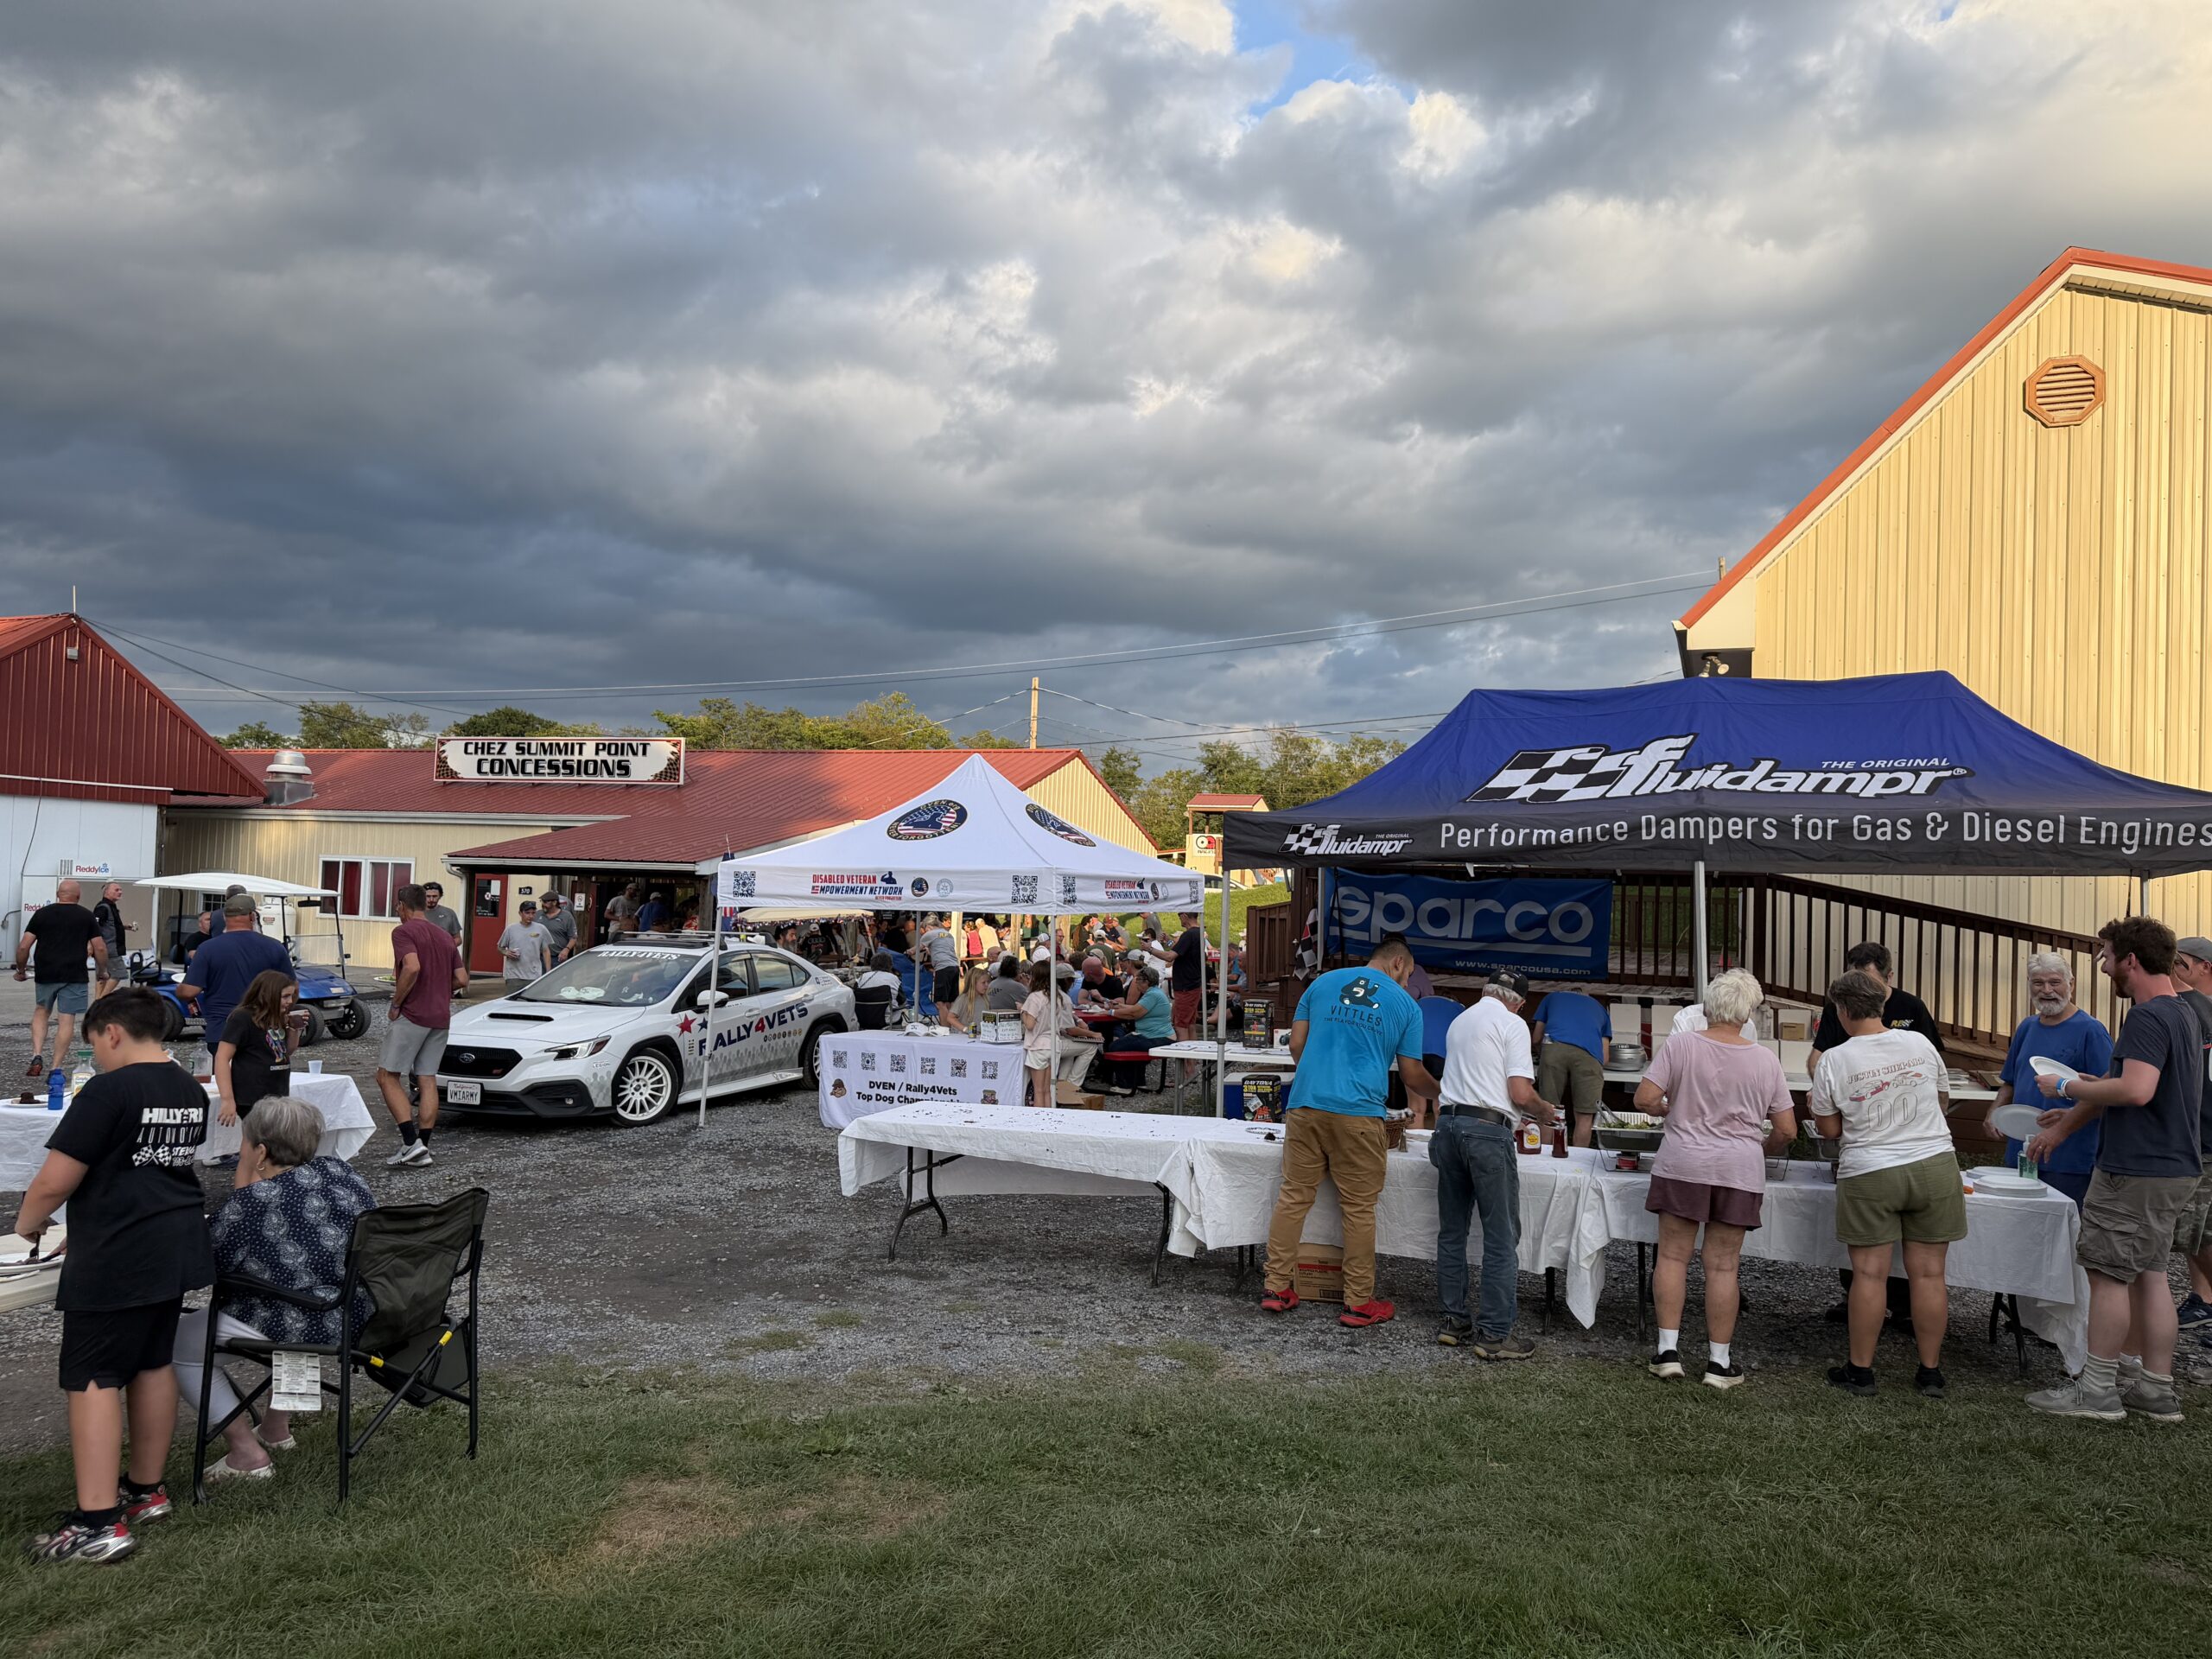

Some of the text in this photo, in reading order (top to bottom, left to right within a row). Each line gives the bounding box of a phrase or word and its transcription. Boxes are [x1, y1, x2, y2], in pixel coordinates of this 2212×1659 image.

[464, 741, 650, 756] CHEZ SUMMIT POINT
[476, 758, 631, 778] CONCESSIONS
[1821, 757, 1949, 769] THE ORIGINAL
[1440, 812, 2212, 855] Performance Dampers for Gas & Diesel Engines
[812, 874, 877, 885] DISABLED VETERAN
[868, 886, 904, 895] NETWORK
[1331, 886, 1594, 944] sparco
[1455, 960, 1591, 975] www.sparcousa.com
[1331, 1005, 1382, 1027] VITTLES
[868, 1080, 957, 1096] DVEN / Rally4Vets
[449, 1090, 478, 1102] VMIARMY
[856, 1091, 873, 1102] Top
[875, 1093, 894, 1104] Dog
[1868, 1092, 1917, 1133] 00
